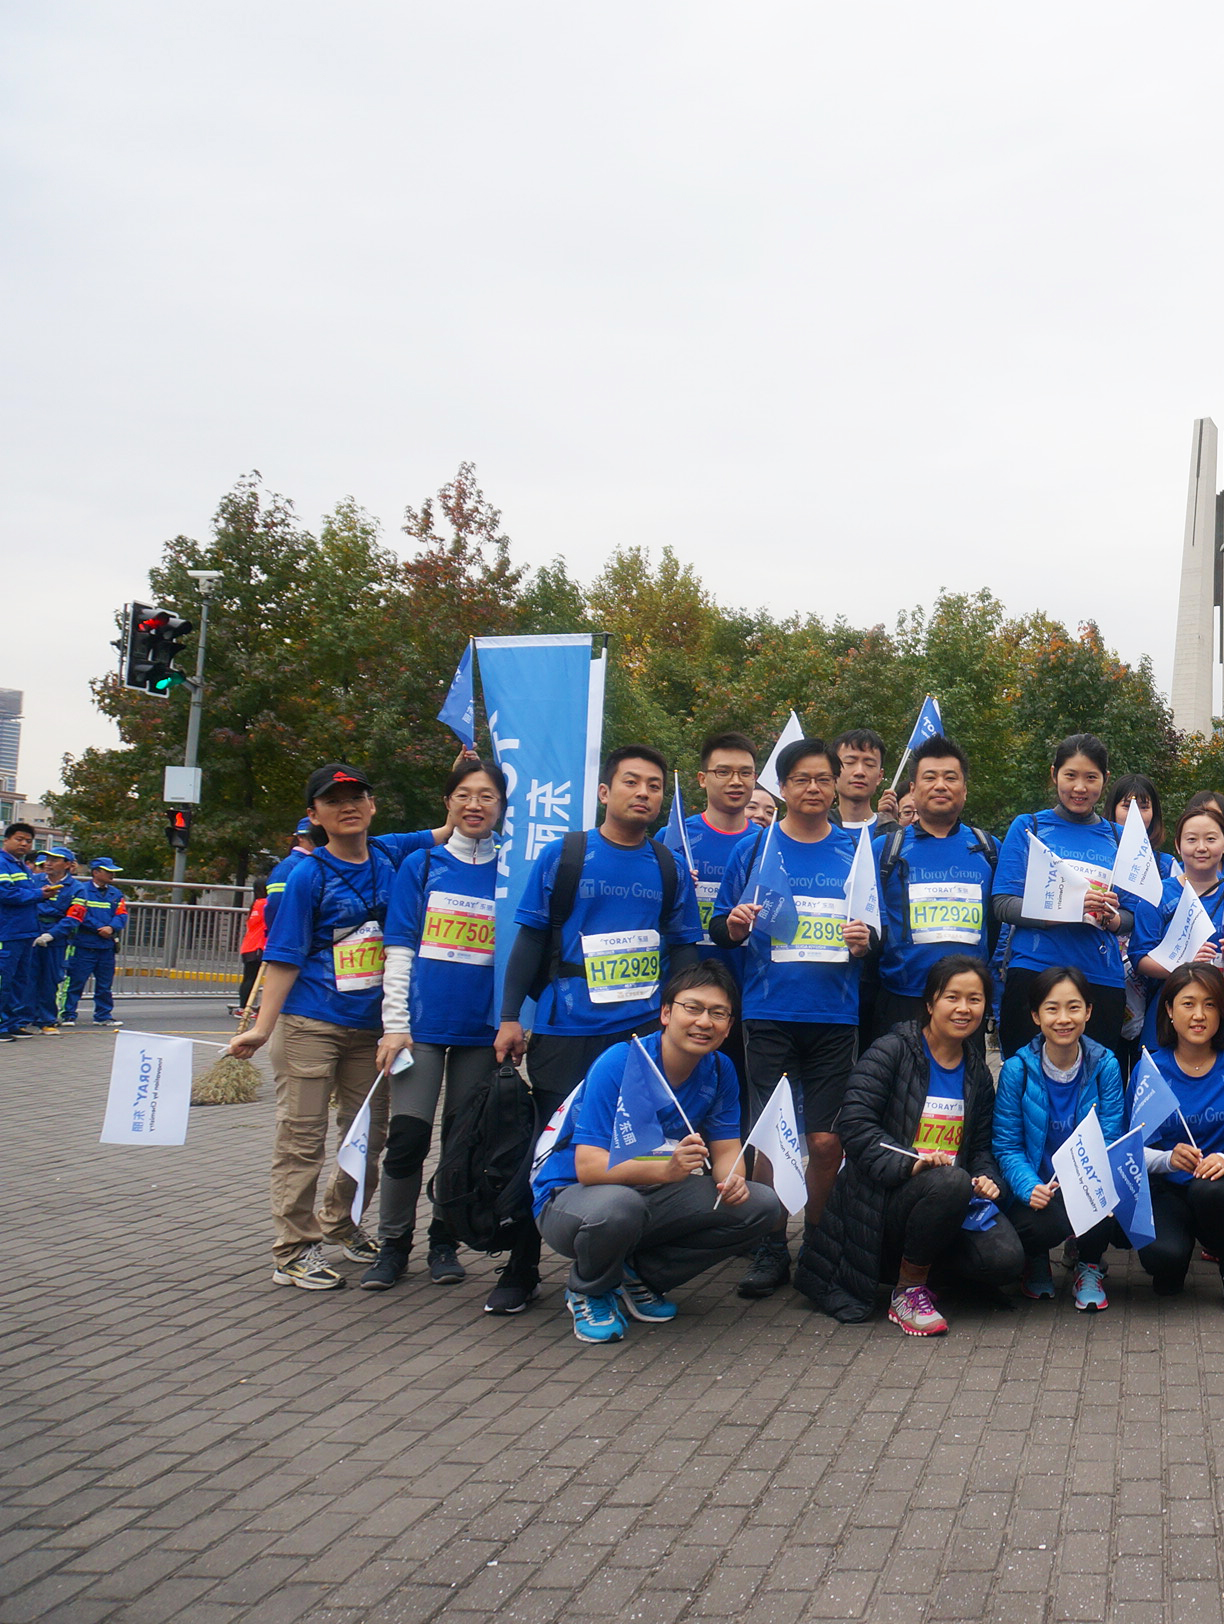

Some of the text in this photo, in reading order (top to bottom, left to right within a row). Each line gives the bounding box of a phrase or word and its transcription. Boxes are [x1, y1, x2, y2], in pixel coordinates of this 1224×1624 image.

[1060, 846, 1085, 860] Toray
[919, 866, 981, 881] Toray Group
[598, 880, 630, 899] Toray
[914, 906, 980, 924] H72920
[799, 921, 844, 942] 2899
[590, 956, 658, 982] H72929
[785, 1151, 792, 1160] by
